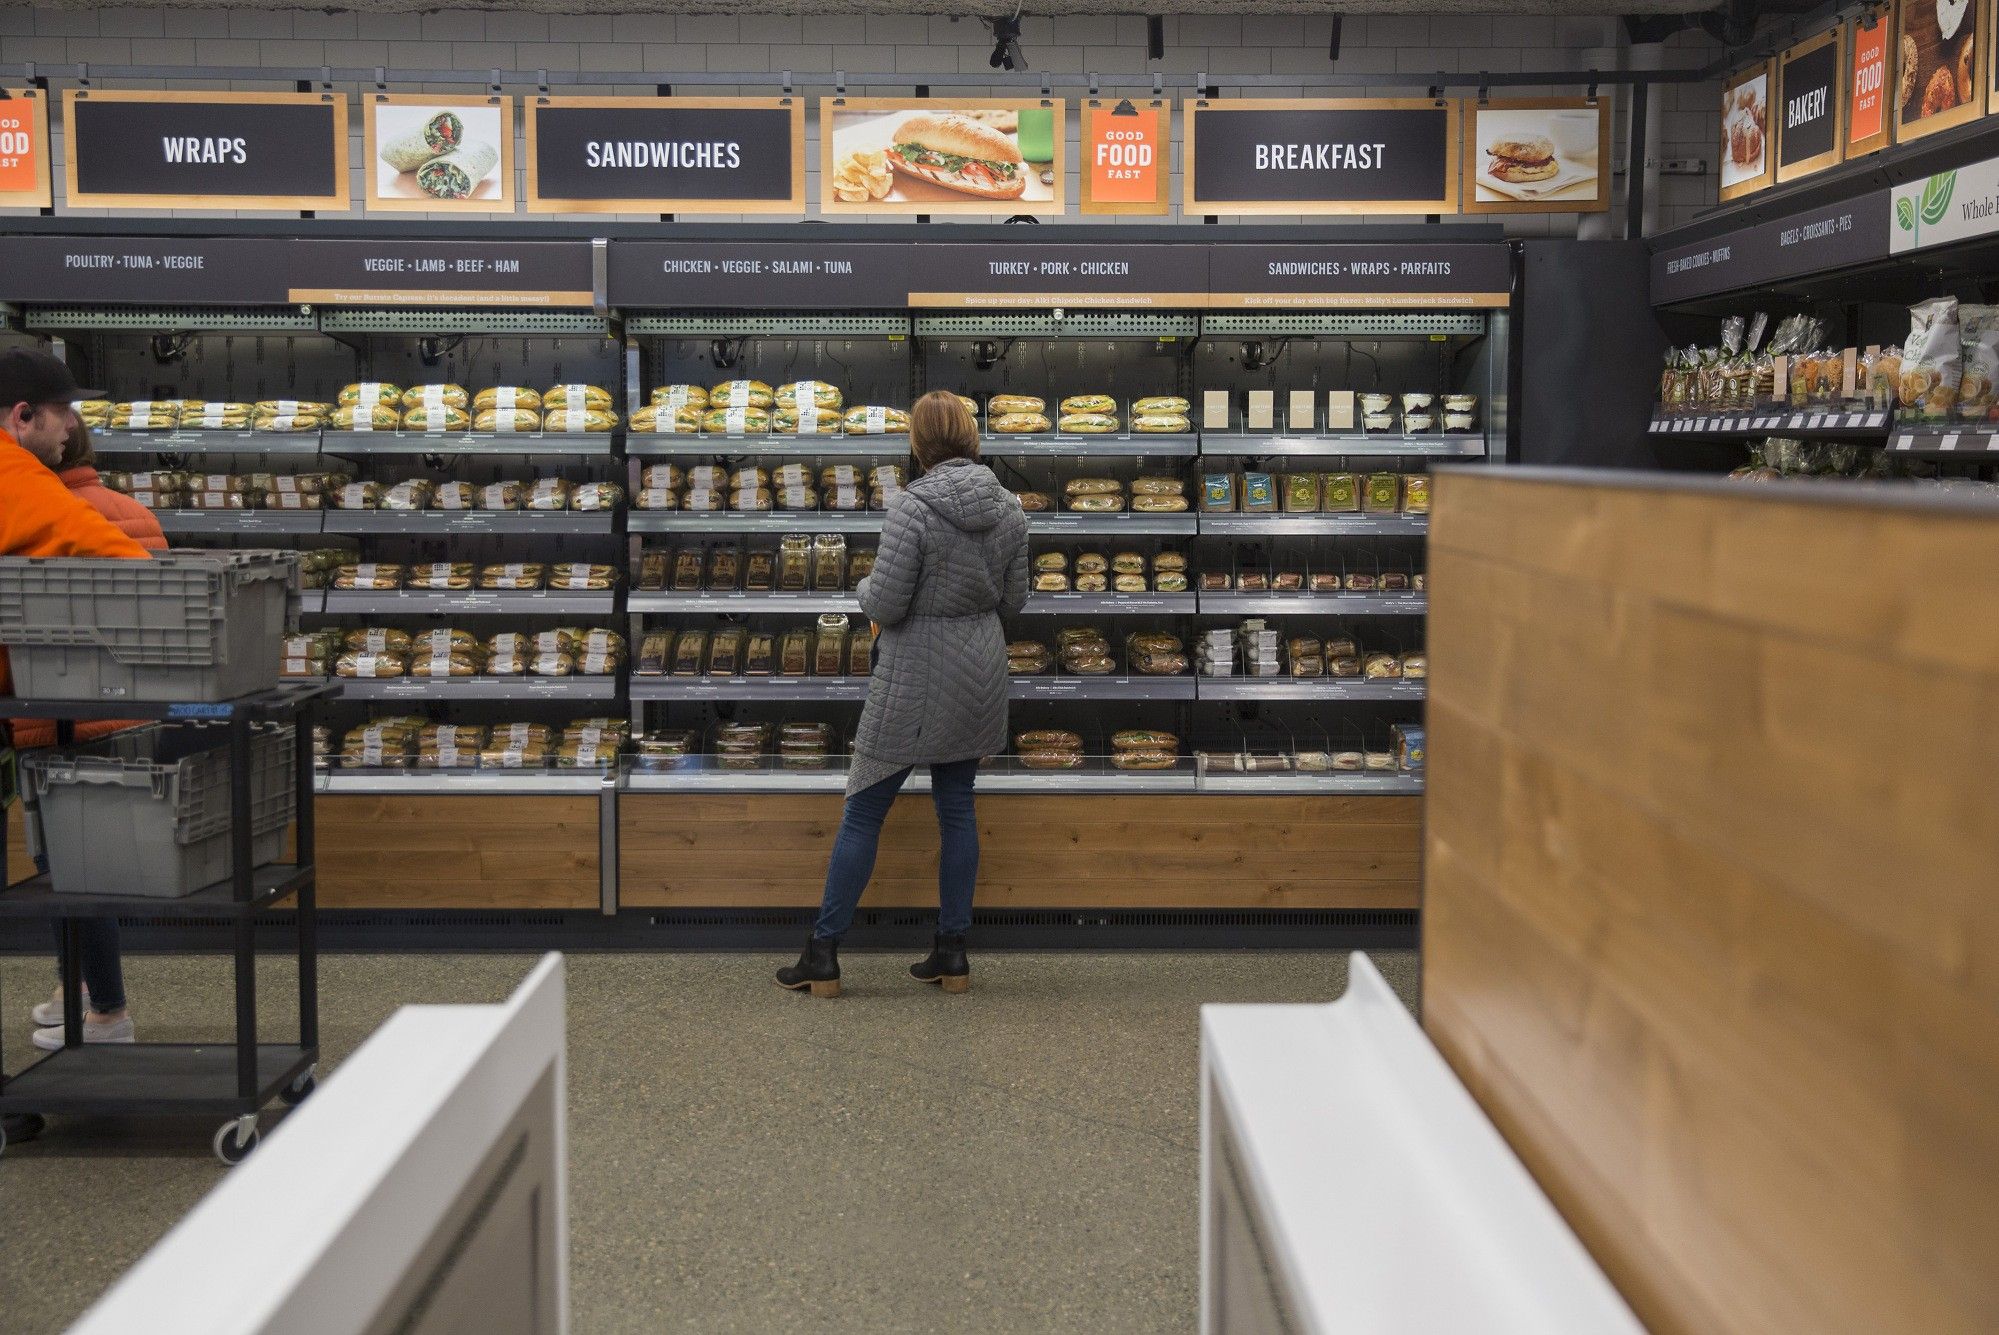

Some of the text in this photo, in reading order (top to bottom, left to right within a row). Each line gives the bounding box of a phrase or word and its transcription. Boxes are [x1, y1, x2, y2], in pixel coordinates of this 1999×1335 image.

[1861, 46, 1880, 64] GOOD
[1855, 61, 1882, 97] FOOD
[1788, 85, 1827, 129] BAKERY
[1859, 95, 1876, 111] FAST
[1105, 131, 1144, 141] GOOD
[162, 136, 248, 165] WRAPS
[586, 140, 741, 170] SANDWICHES
[1097, 143, 1152, 167] FOOD
[1254, 142, 1386, 171] BREAKFAST
[1107, 169, 1141, 179] FAST
[1962, 197, 1994, 221] Whole
[66, 254, 204, 269] POULTRY TUNA VEGGIE
[364, 258, 519, 273] VEGGIE LAMB BEEF HAM
[664, 260, 852, 274] CHICKEN VEGGIE SALAMI TUNA
[989, 262, 1129, 275] TURKEY PORK CHICKEN
[1268, 262, 1451, 275] SANDWICHES WRAPS PARFAITS
[965, 297, 986, 305] Spice
[999, 298, 1015, 306] your
[1084, 297, 1114, 305] Chicken
[1115, 297, 1152, 305] Sandwich
[1293, 297, 1306, 305] day
